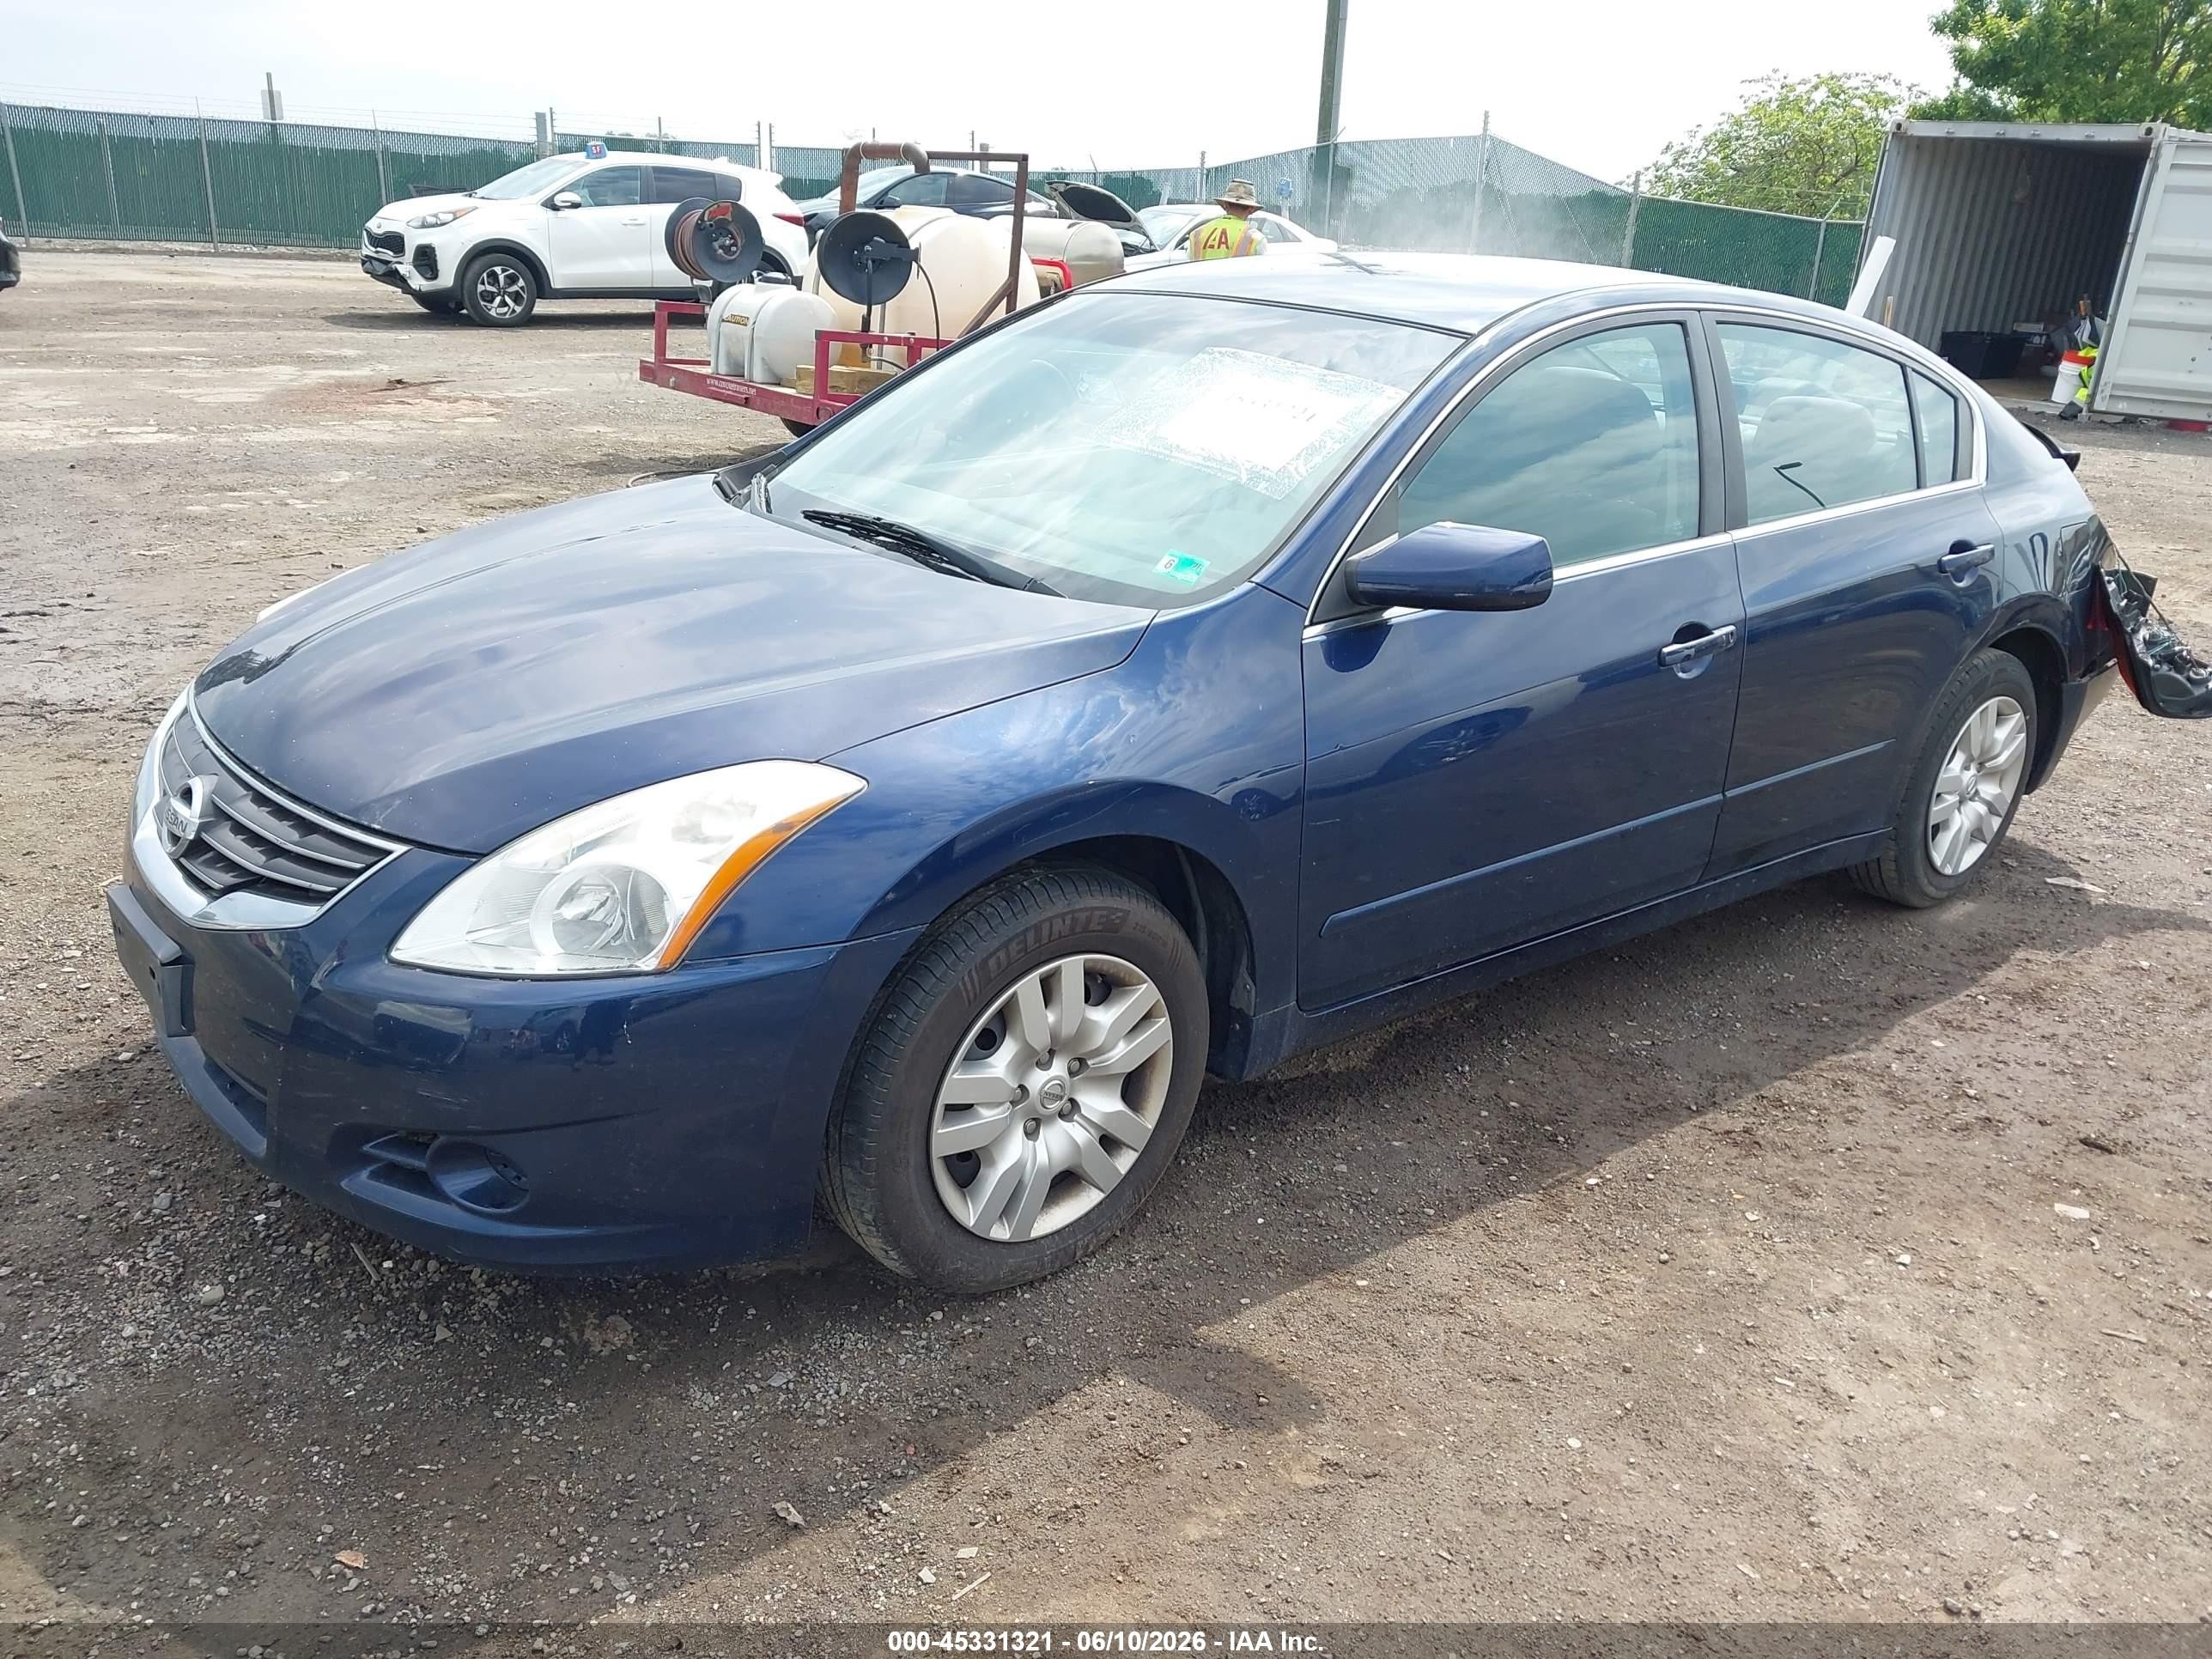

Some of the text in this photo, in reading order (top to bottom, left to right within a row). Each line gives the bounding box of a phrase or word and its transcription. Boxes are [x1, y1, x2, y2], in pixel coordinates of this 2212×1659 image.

[1164, 559, 1175, 568] 6
[166, 810, 188, 833] SSAN
[988, 909, 1123, 981] DELINTE
